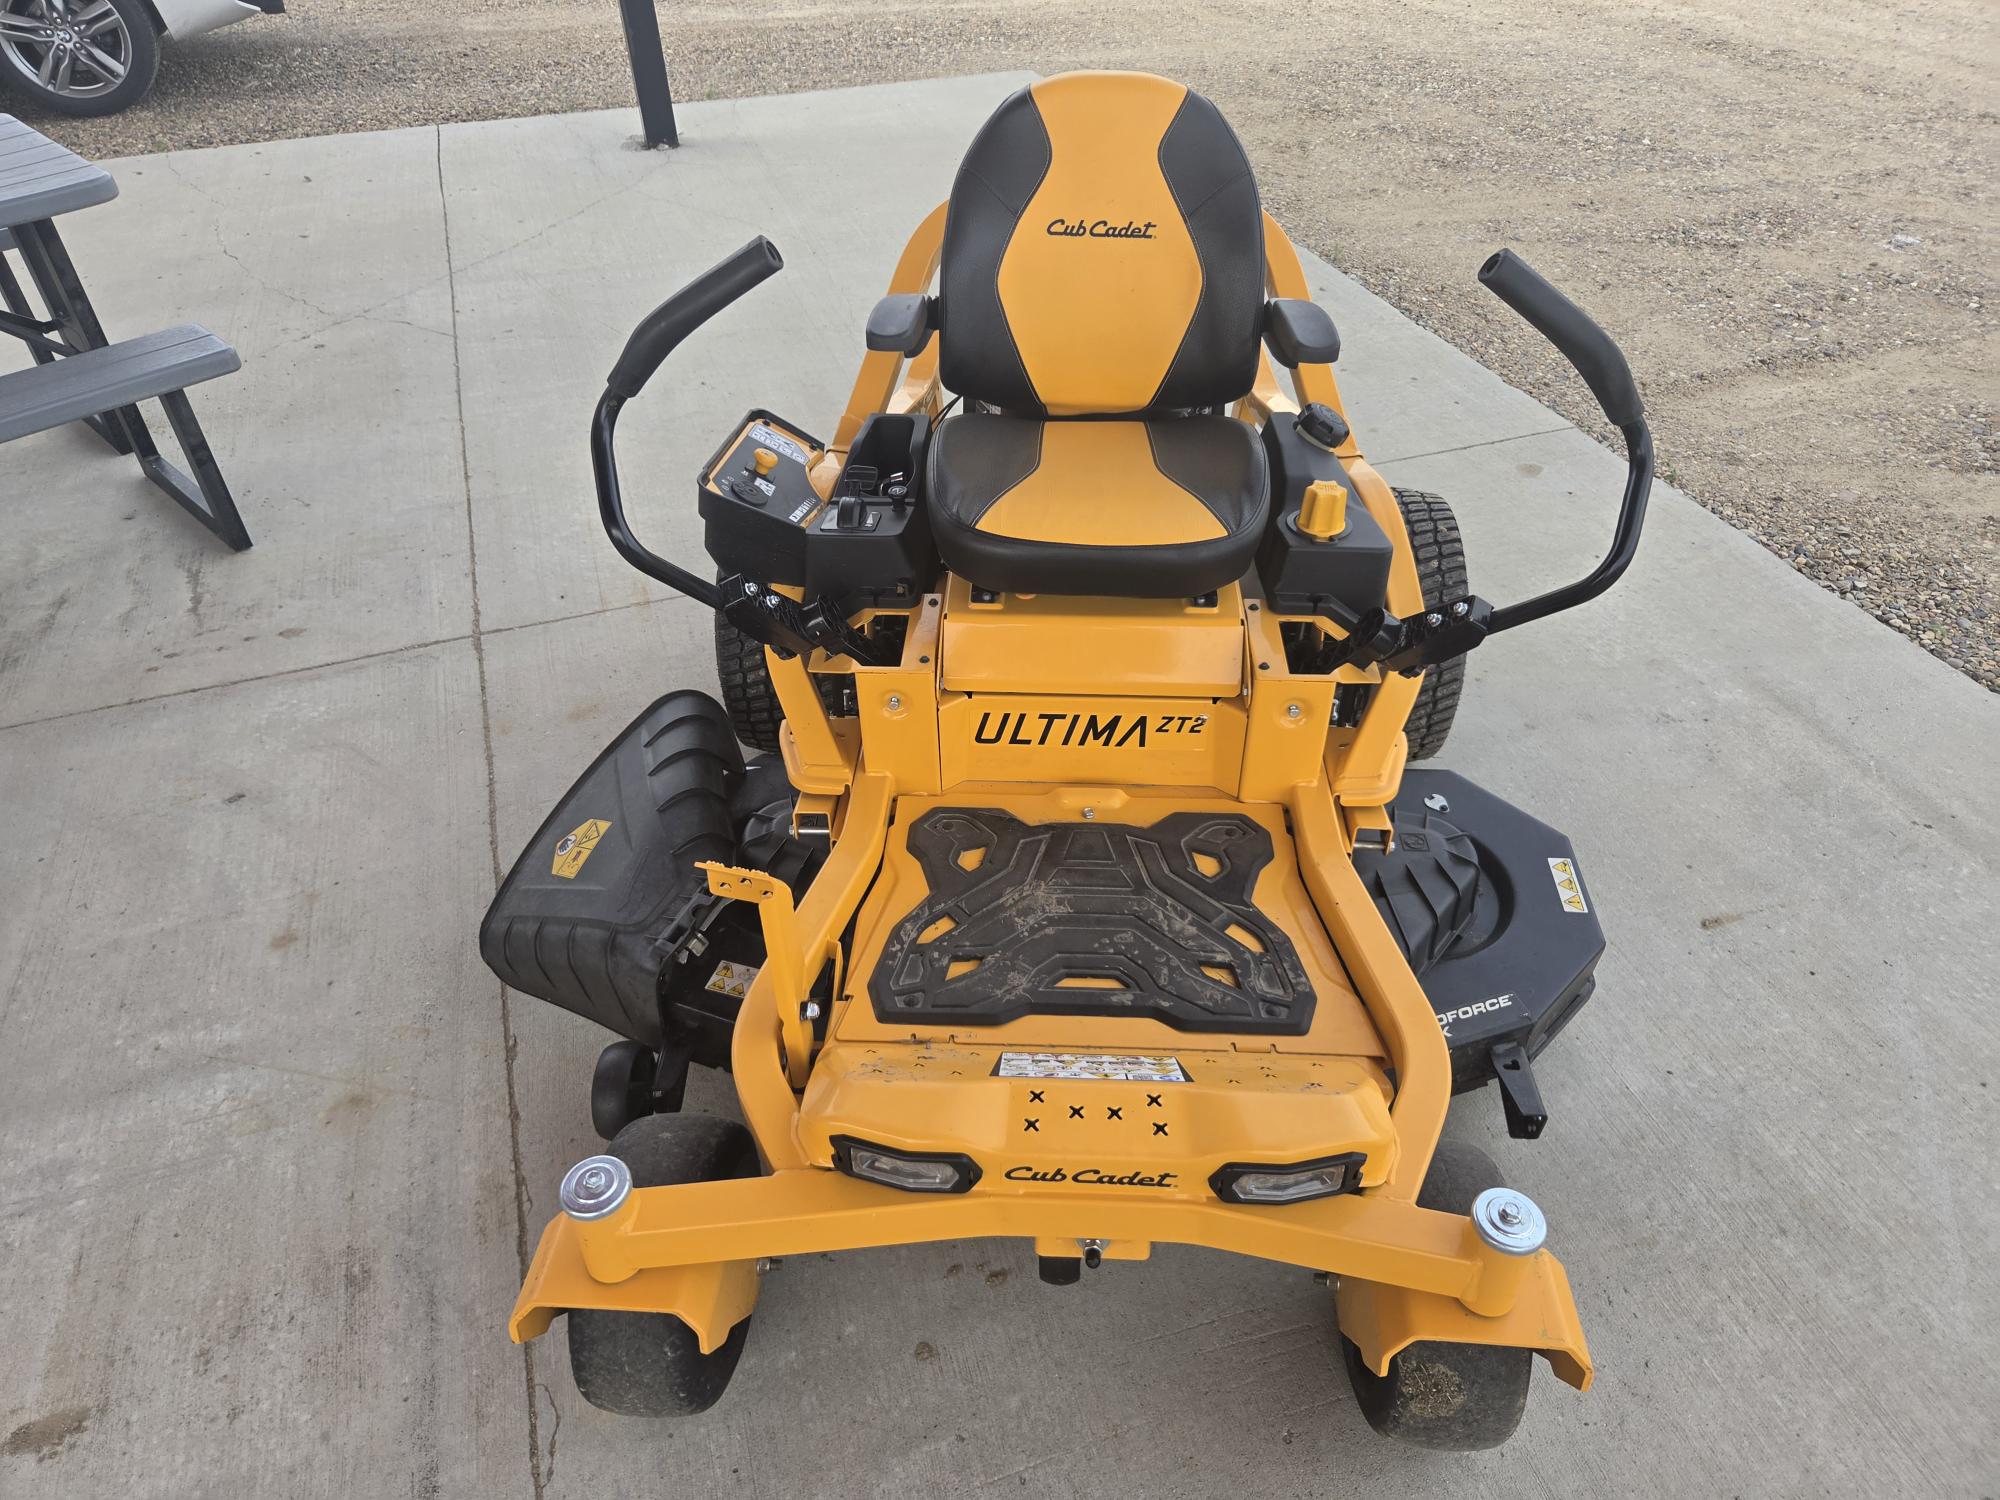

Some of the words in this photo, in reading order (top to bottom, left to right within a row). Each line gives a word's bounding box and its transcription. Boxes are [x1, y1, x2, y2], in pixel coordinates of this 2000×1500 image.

[1047, 218, 1087, 236] Cub
[1089, 220, 1157, 239] Cadet
[974, 712, 1148, 747] ULTIMA
[1155, 716, 1208, 733] ZT2
[1004, 1166, 1067, 1182] Cub
[1071, 1169, 1178, 1188] Cadet
